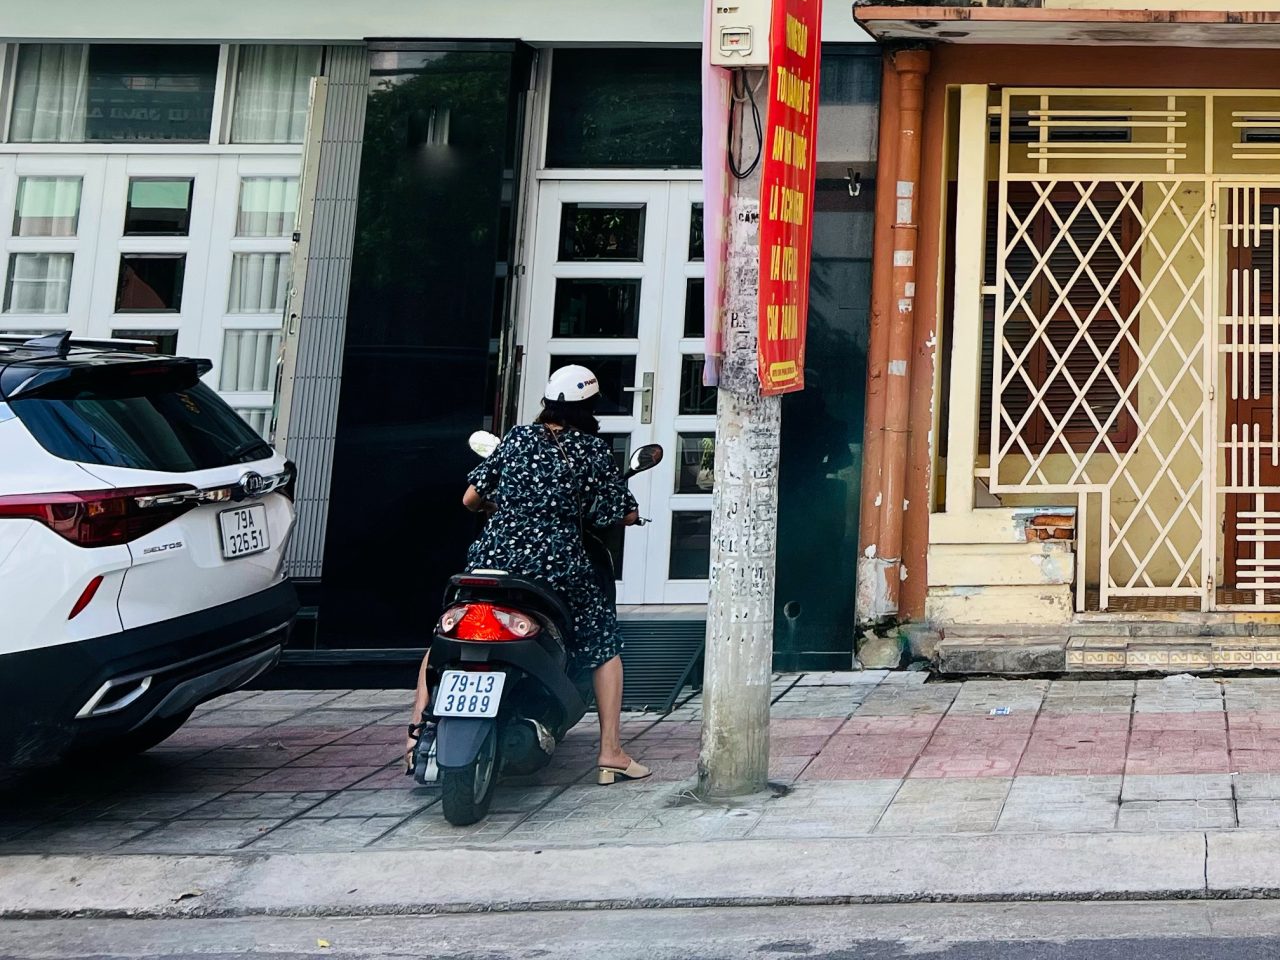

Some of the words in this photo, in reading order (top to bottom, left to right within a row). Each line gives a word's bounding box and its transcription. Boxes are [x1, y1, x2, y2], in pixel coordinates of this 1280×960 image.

[234, 509, 255, 531] 79A
[143, 541, 183, 555] SELTOS
[230, 529, 264, 555] 326.51
[450, 674, 495, 693] 79-L3
[444, 694, 490, 713] 3889
